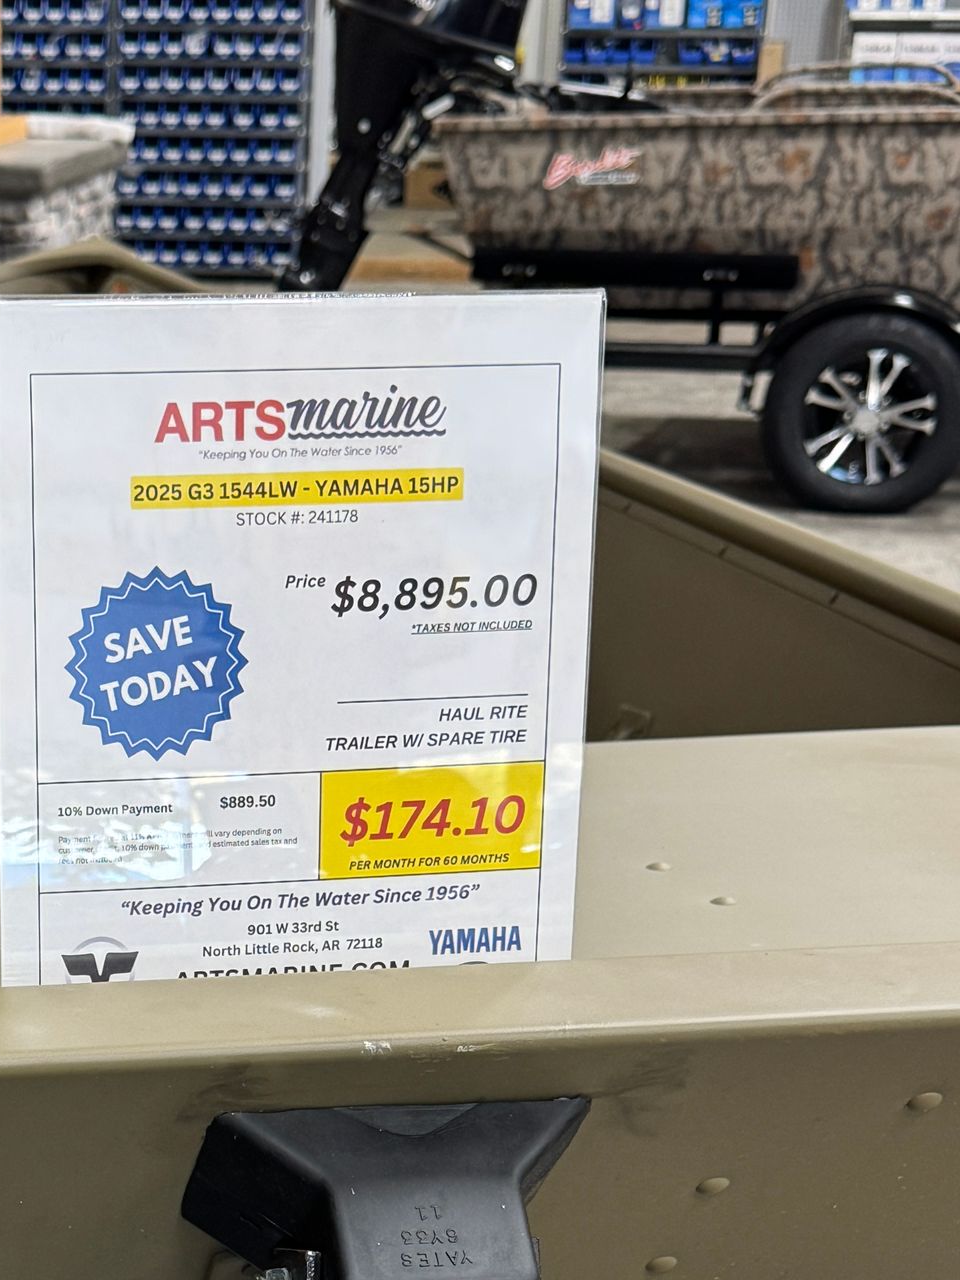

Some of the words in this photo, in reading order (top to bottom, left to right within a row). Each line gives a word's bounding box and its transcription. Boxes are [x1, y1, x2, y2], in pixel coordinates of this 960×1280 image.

[249, 448, 269, 459] You
[272, 447, 287, 458] On
[290, 447, 308, 458] The
[311, 446, 341, 457] Water
[344, 445, 372, 456] Since
[133, 483, 182, 501] 2025
[188, 482, 214, 500] G3
[219, 480, 297, 499] 1544LW
[315, 478, 403, 497] YAMAHA
[408, 476, 459, 494] 15HP
[236, 511, 287, 526] STOCK
[290, 511, 305, 524] #:
[308, 509, 358, 524] 241178
[285, 574, 326, 589] Price
[331, 573, 538, 619] $8,895.00
[453, 621, 477, 633] NOT
[479, 619, 532, 632] INCLUDED
[104, 615, 193, 663] SAVE
[99, 656, 217, 711] TODAY
[439, 706, 485, 721] HAUL
[490, 705, 528, 719] RITE
[326, 735, 398, 751] TRAILER
[403, 733, 424, 748] W/
[427, 731, 485, 747] SPARE
[490, 729, 528, 744] TIRE
[58, 806, 83, 817] 10%
[85, 805, 118, 816] Down
[121, 803, 173, 816] Payment
[220, 794, 276, 810] $889.50
[340, 794, 526, 847] $174.10
[214, 830, 230, 838] vary
[232, 828, 271, 837] depending
[138, 843, 160, 852] down
[213, 839, 250, 847] estimated
[251, 838, 269, 846] sales
[284, 837, 298, 845] and
[349, 859, 371, 870] PER
[373, 857, 416, 869] MONTH
[418, 856, 440, 867] FOR
[444, 855, 457, 866] 60
[460, 853, 510, 865] MONTHS
[121, 898, 203, 918] “Keeping
[209, 897, 242, 912] You
[247, 895, 272, 910] On
[278, 893, 310, 908] The
[315, 891, 370, 907] Water
[373, 888, 422, 904] Since
[425, 883, 480, 901] 1956”
[247, 924, 272, 936] 901
[276, 922, 288, 934] W
[291, 920, 322, 934] 33rd
[325, 920, 339, 932] St
[202, 945, 241, 957] North
[245, 943, 280, 956] Little
[283, 940, 318, 954] Rock,
[322, 940, 340, 951] AR
[346, 937, 383, 950] 72118
[429, 925, 522, 955] YAMAHA
[400, 1250, 473, 1268] YATES
